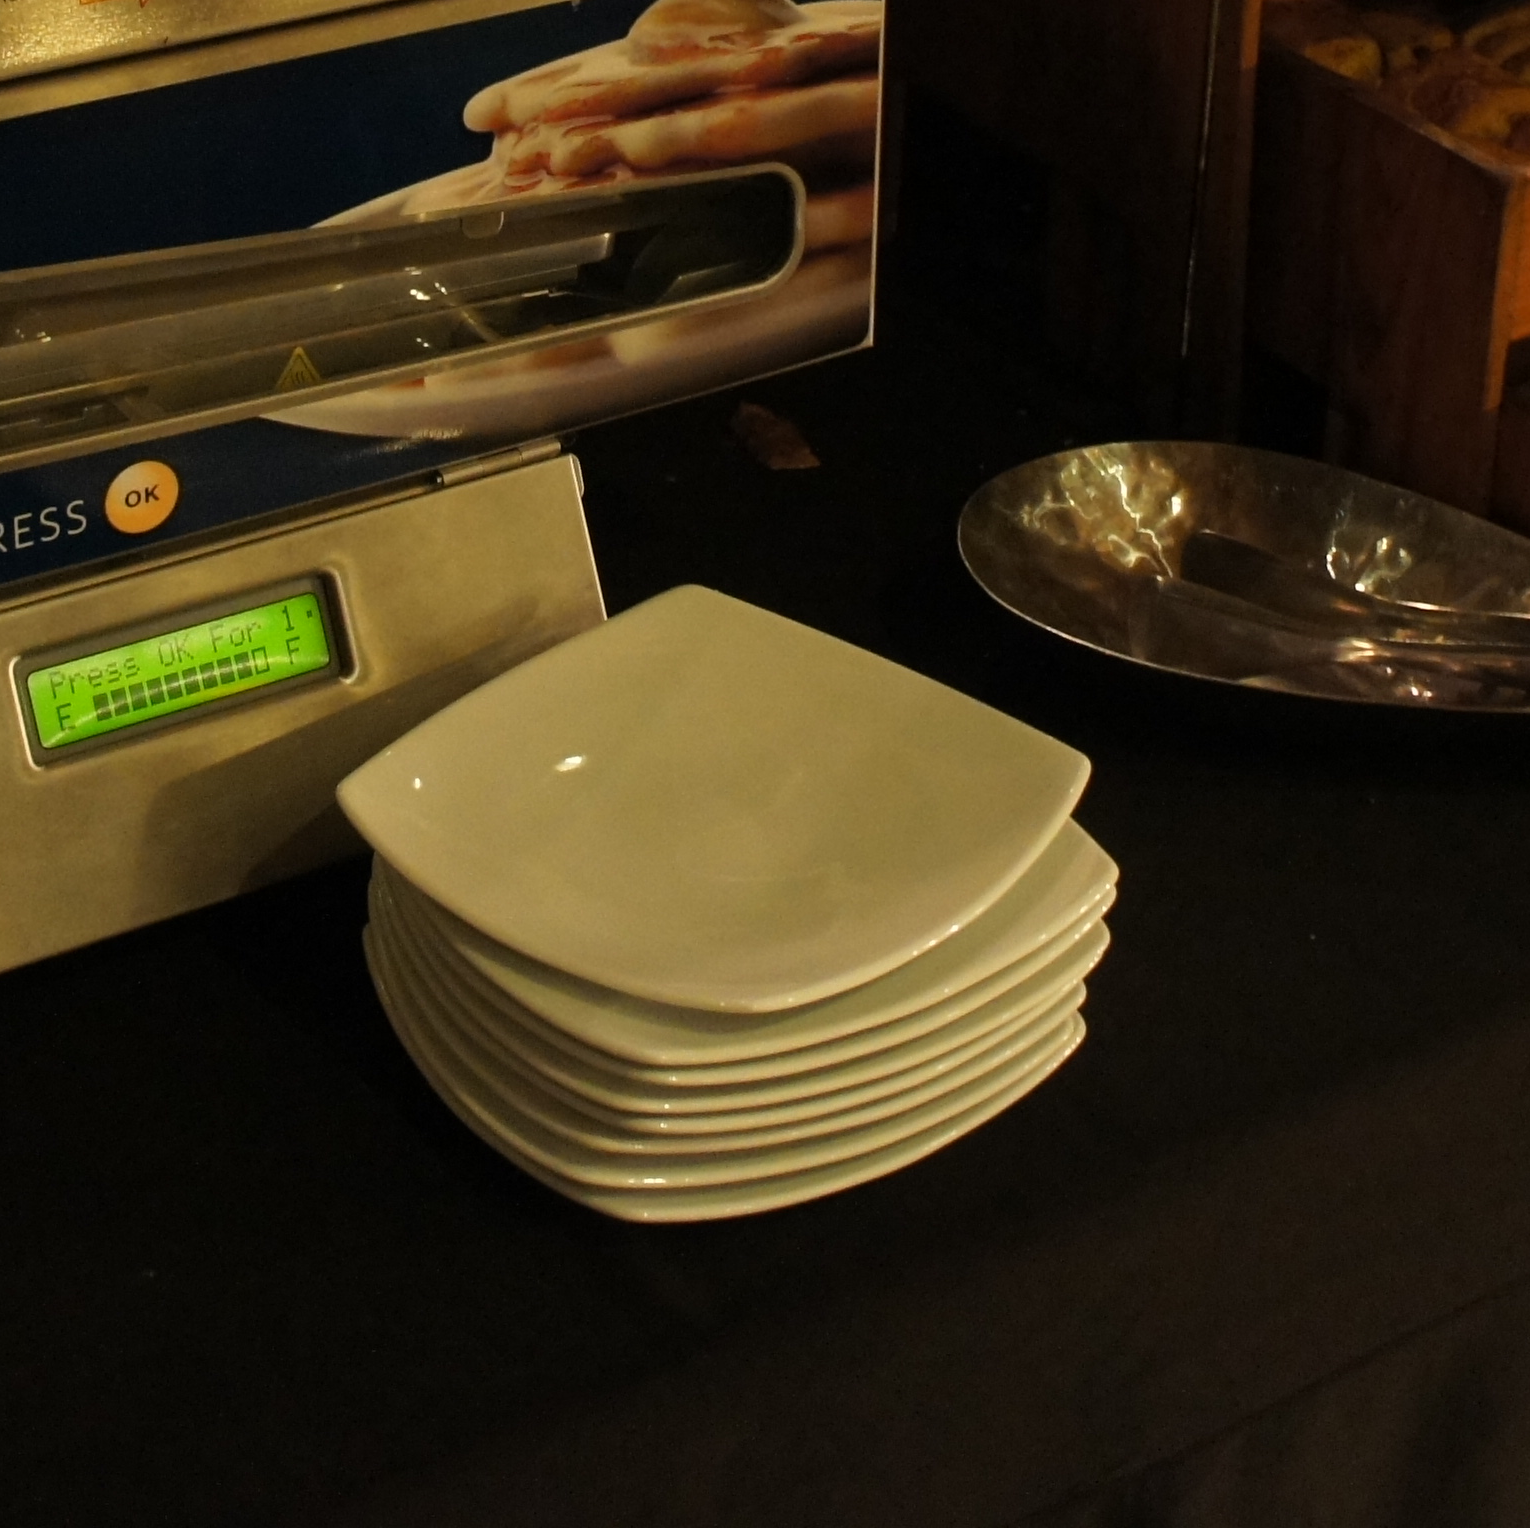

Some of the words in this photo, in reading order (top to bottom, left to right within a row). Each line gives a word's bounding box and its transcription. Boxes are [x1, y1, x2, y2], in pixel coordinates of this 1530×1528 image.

[124, 484, 160, 508] OK
[47, 656, 142, 700] Press
[157, 634, 195, 668] OK
[208, 621, 262, 653] For
[281, 605, 296, 633] 1
[55, 702, 76, 732] E
[285, 635, 302, 665] F
